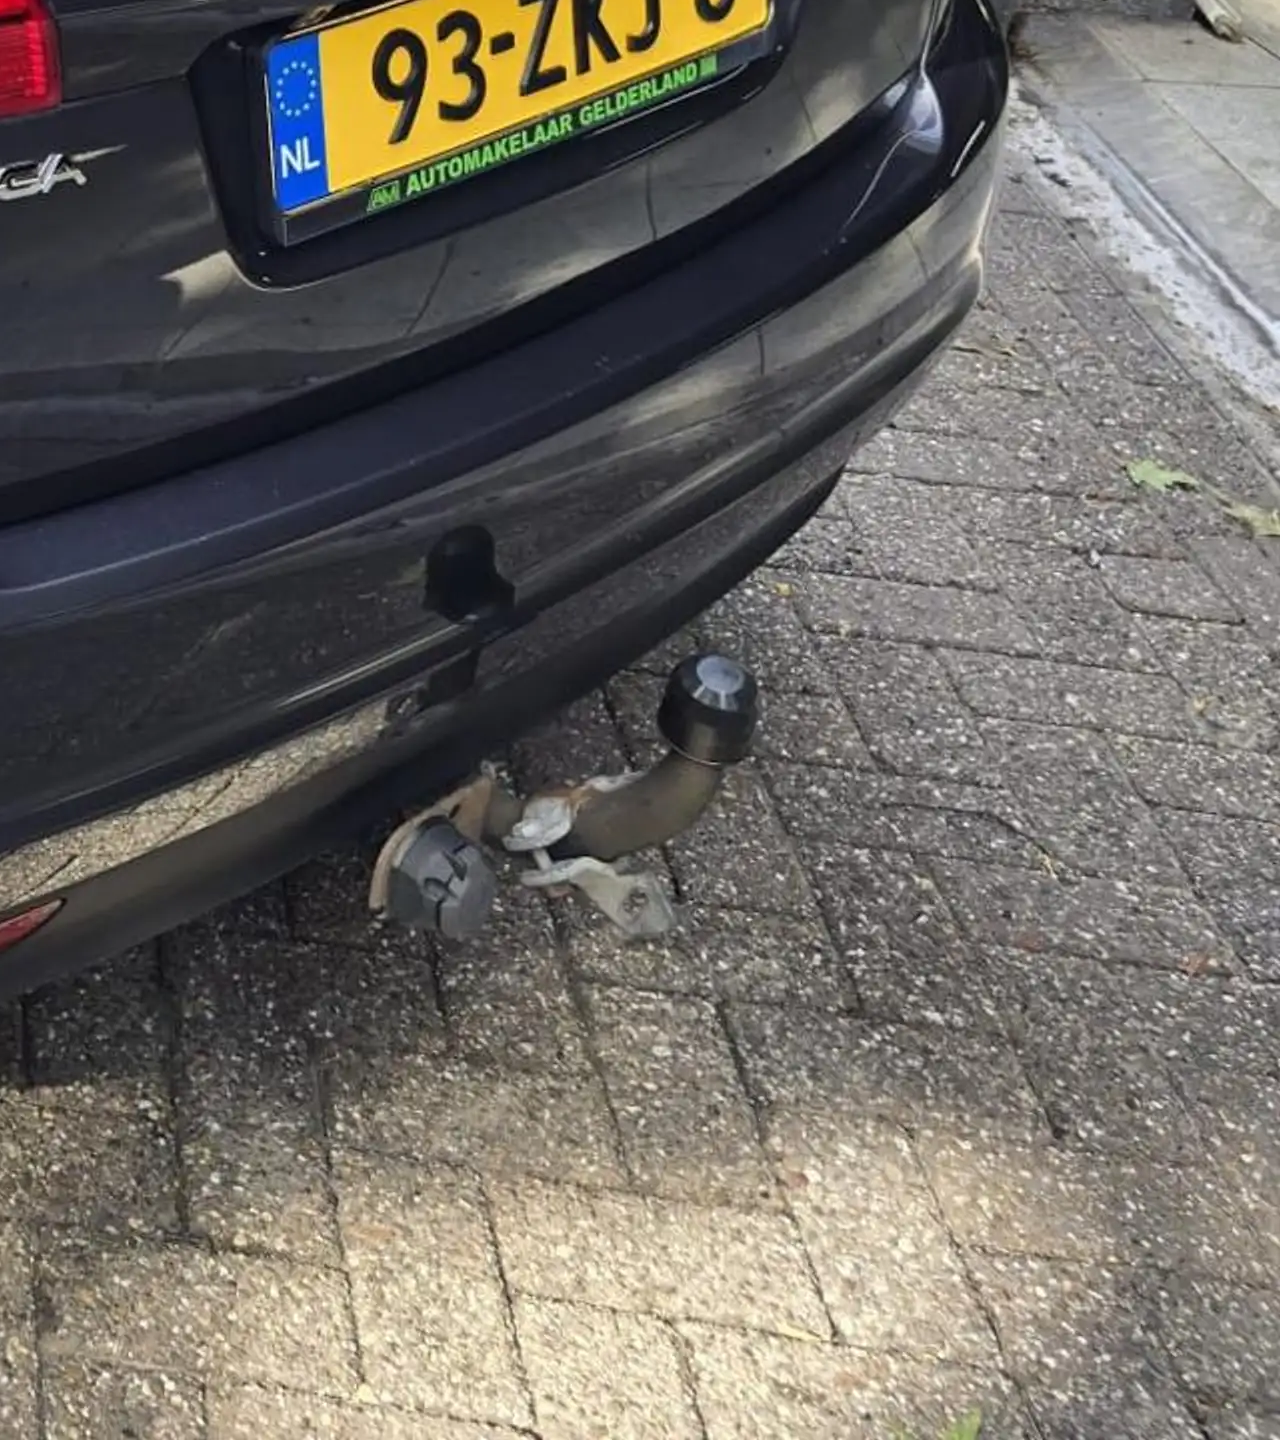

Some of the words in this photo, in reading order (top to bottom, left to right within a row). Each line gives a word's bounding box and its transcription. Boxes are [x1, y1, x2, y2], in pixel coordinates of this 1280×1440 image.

[279, 135, 321, 179] NL
[406, 114, 574, 196] AUTOMAKELAAR
[579, 62, 698, 127] GELDERLAND
